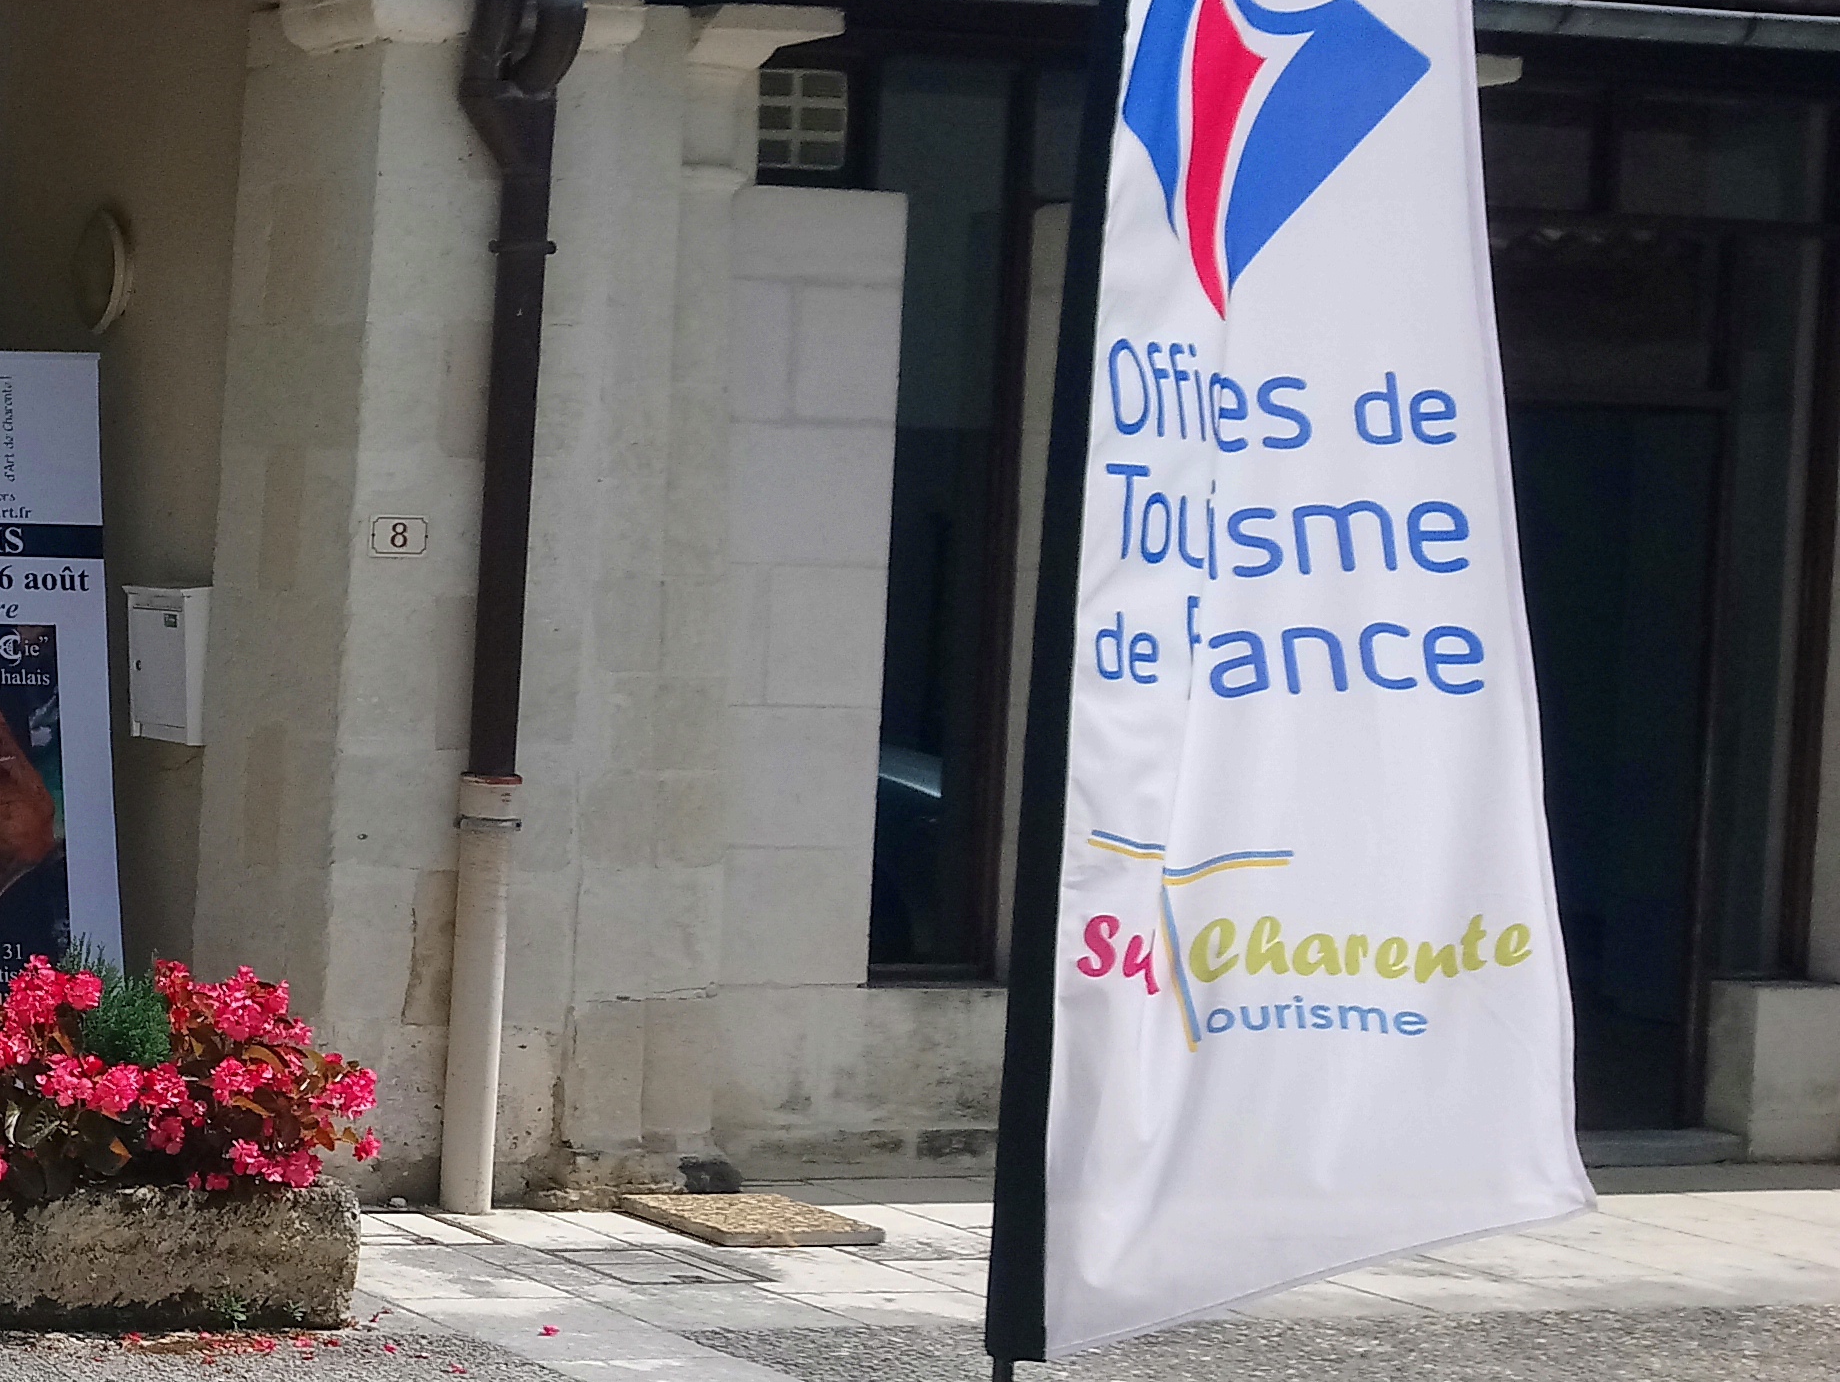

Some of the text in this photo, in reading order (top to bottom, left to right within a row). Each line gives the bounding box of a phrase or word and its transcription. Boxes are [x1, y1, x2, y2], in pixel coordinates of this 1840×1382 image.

[1353, 372, 1458, 447] de
[389, 522, 408, 549] 8
[1105, 463, 1470, 580] Touisme
[24, 566, 90, 592] août
[1094, 594, 1485, 699] de Fance
[2, 943, 23, 960] 31
[1076, 913, 1534, 996] Su Charente
